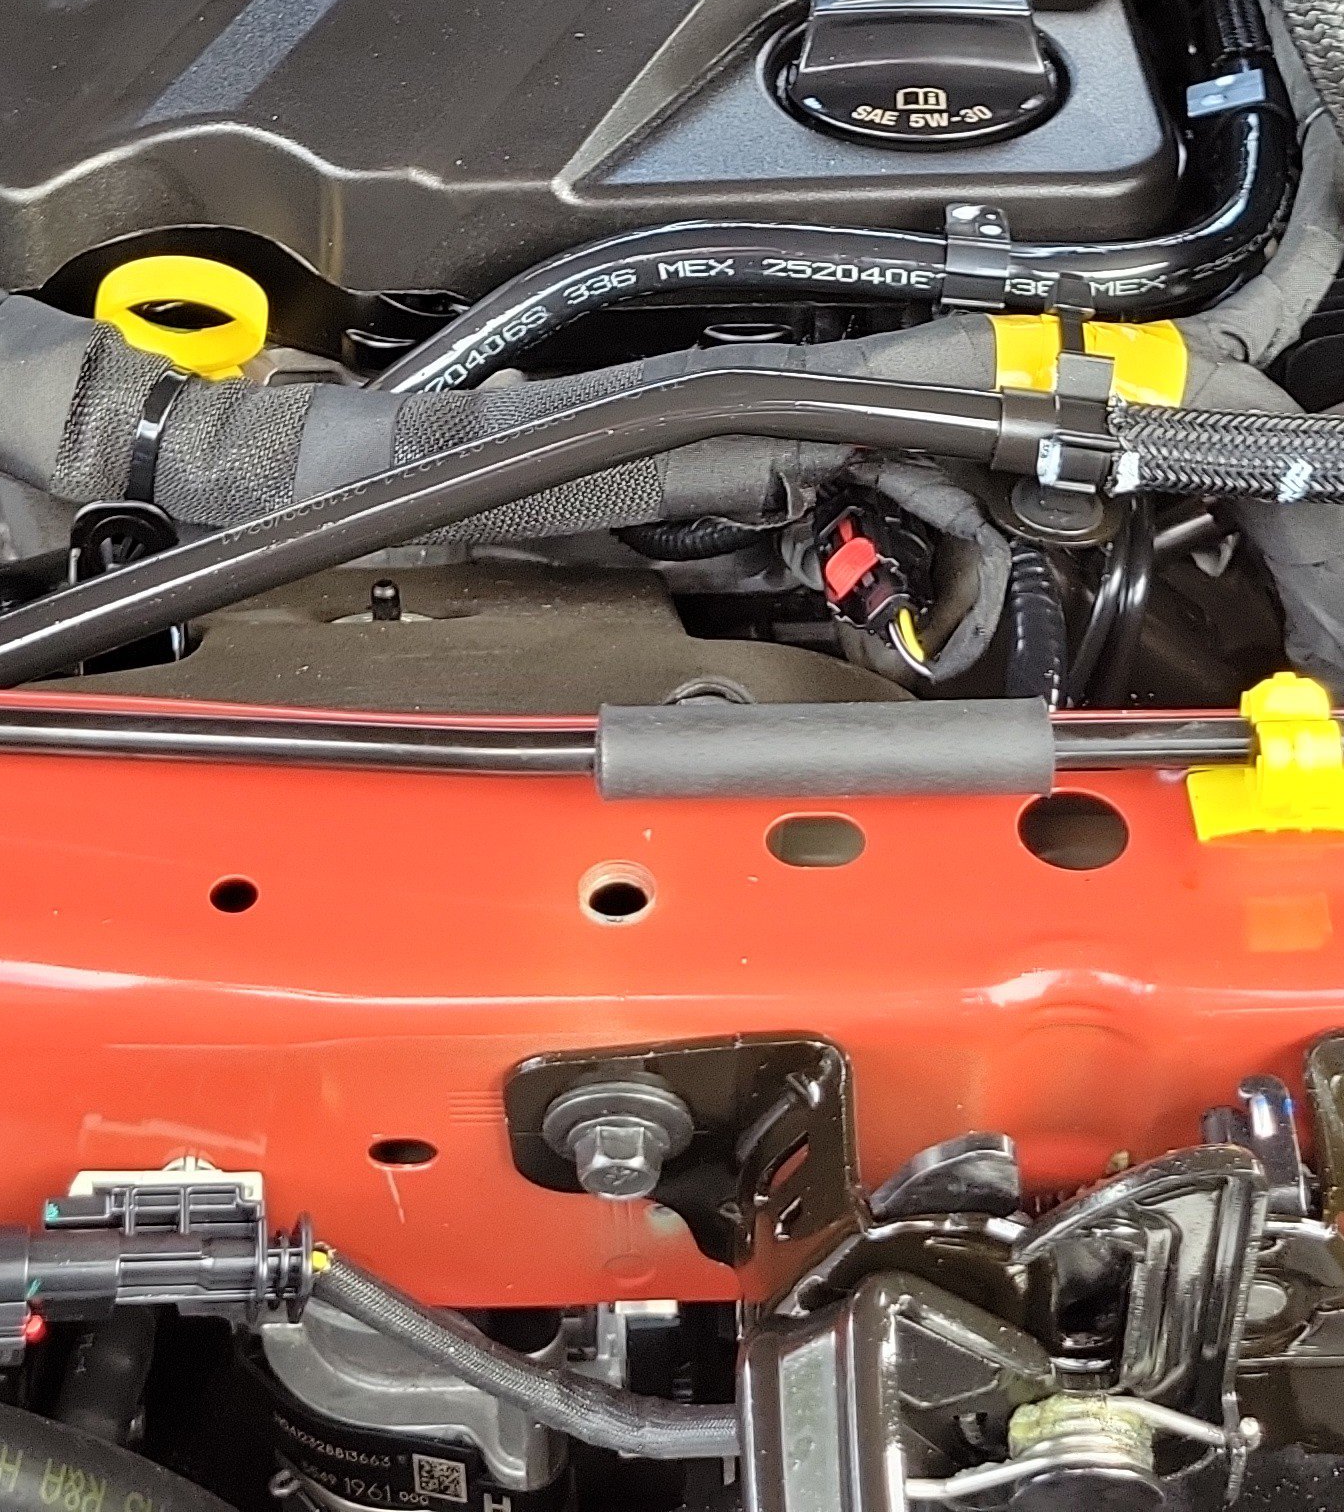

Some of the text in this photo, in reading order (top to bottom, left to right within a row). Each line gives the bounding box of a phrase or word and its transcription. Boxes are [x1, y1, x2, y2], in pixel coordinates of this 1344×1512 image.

[851, 105, 992, 128] SAE 5W-30
[562, 267, 637, 306] 336
[657, 258, 735, 281] MEX
[1004, 278, 1055, 297] 36
[1089, 274, 1168, 297] MEX
[343, 1477, 392, 1503] 1961
